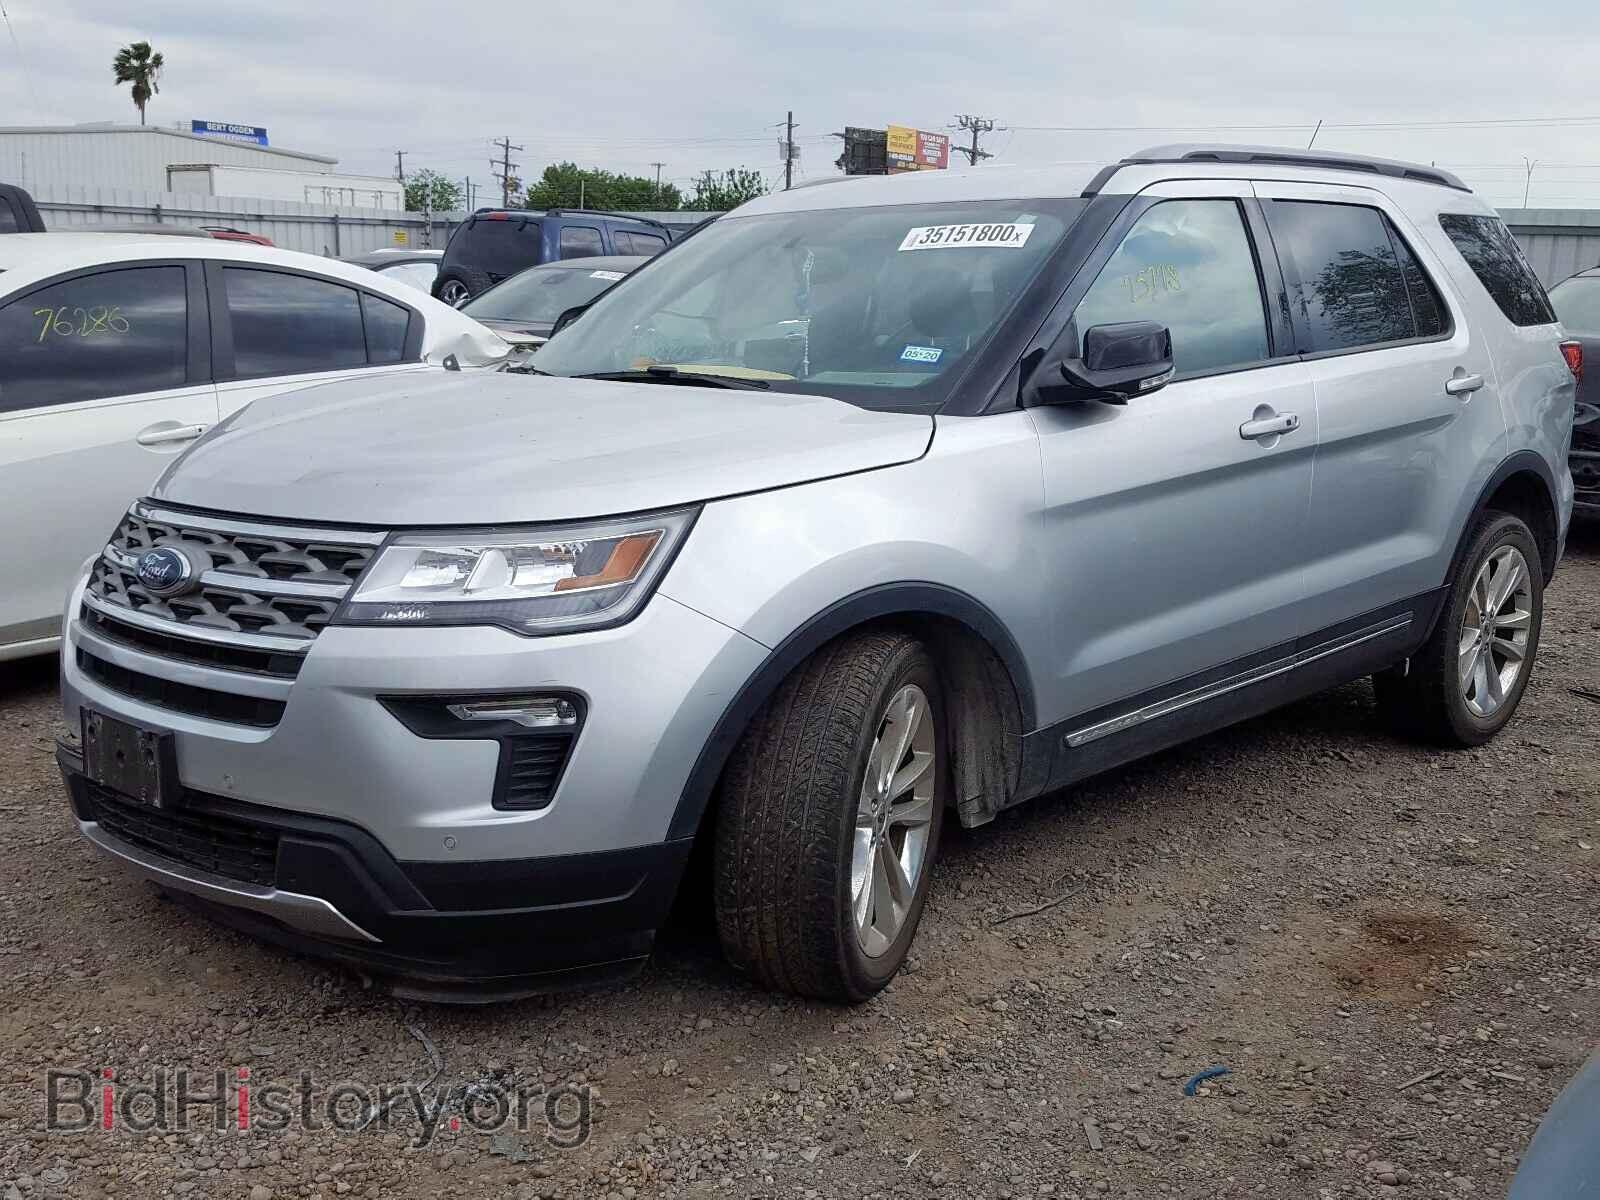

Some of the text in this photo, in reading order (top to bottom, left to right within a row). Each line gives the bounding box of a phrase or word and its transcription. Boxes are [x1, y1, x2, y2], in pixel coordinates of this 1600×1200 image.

[206, 122, 255, 135] BERT OGDEN
[34, 305, 129, 342] 76286
[139, 552, 172, 579] Ford
